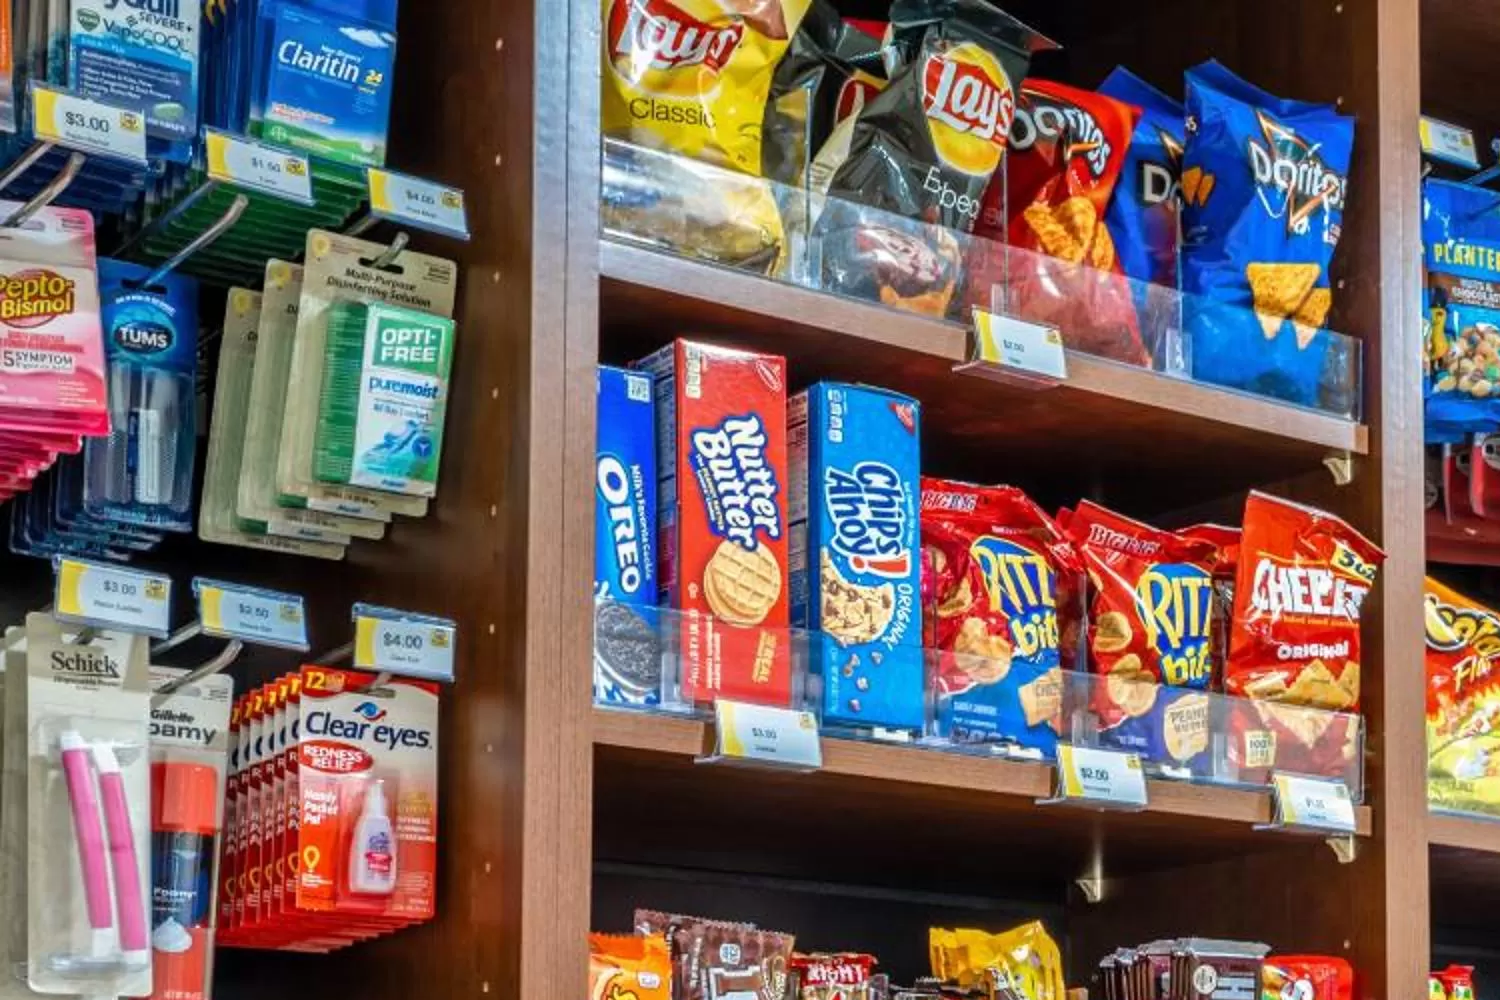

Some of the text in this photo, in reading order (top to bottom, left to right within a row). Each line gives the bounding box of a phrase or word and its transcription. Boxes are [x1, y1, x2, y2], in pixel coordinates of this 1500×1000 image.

[139, 11, 185, 32] SEVERE
[278, 40, 359, 82] Claritin
[65, 111, 109, 133] $3.00
[630, 98, 717, 129] Classic
[345, 268, 417, 292] Multi-Purpose
[0, 292, 74, 319] Bismol
[388, 288, 432, 308] Solution
[119, 326, 168, 348] TUMS
[381, 328, 436, 346] OPTI-
[16, 351, 72, 367] SYMPTOM
[380, 346, 436, 363] FREE
[369, 376, 439, 399] puremoist
[724, 415, 780, 537] Nutter
[693, 429, 755, 548] Butter
[855, 462, 903, 556] Chips
[597, 456, 641, 593] OREO
[383, 632, 423, 649] $4.00
[52, 651, 118, 677] Schick
[151, 710, 195, 724] Gillette
[150, 723, 216, 745] oamy
[306, 712, 432, 751] Clear eyes
[303, 745, 363, 764] REDNESS
[311, 757, 354, 773] RELIEF
